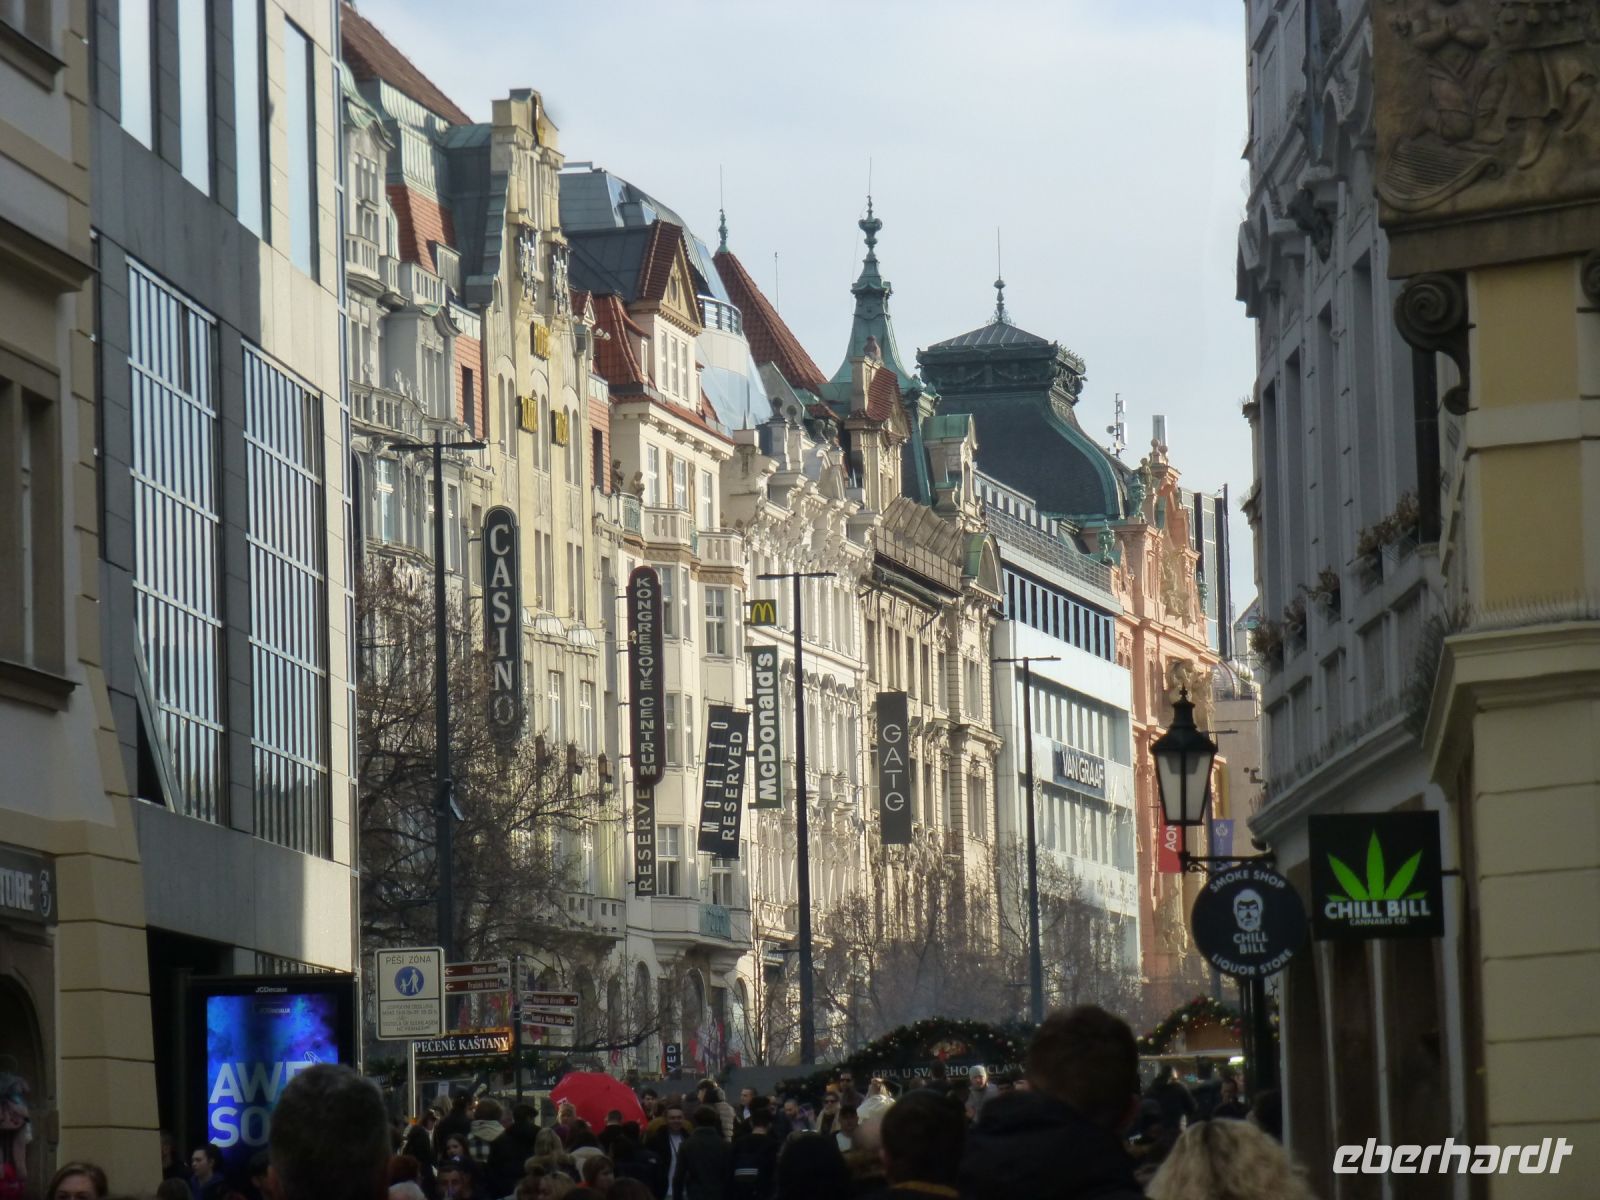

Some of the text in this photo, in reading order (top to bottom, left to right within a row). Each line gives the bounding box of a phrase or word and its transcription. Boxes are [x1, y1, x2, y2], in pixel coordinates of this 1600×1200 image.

[490, 524, 514, 726] CASINO
[639, 697, 657, 776] CENTRUM
[756, 652, 777, 801] McDonald's
[701, 722, 729, 833] MOHITO
[722, 732, 744, 840] RESERVED
[636, 787, 652, 892] RESERVE
[1209, 870, 1286, 893] SMOKE SHOP
[1324, 898, 1431, 919] CHILL BILL
[1349, 917, 1392, 926] CANNABIS
[1232, 931, 1269, 944] CHILL
[1239, 943, 1267, 954] BILL
[1211, 948, 1294, 975] LIQUOR STORE
[458, 1035, 508, 1051] KAŠTANY
